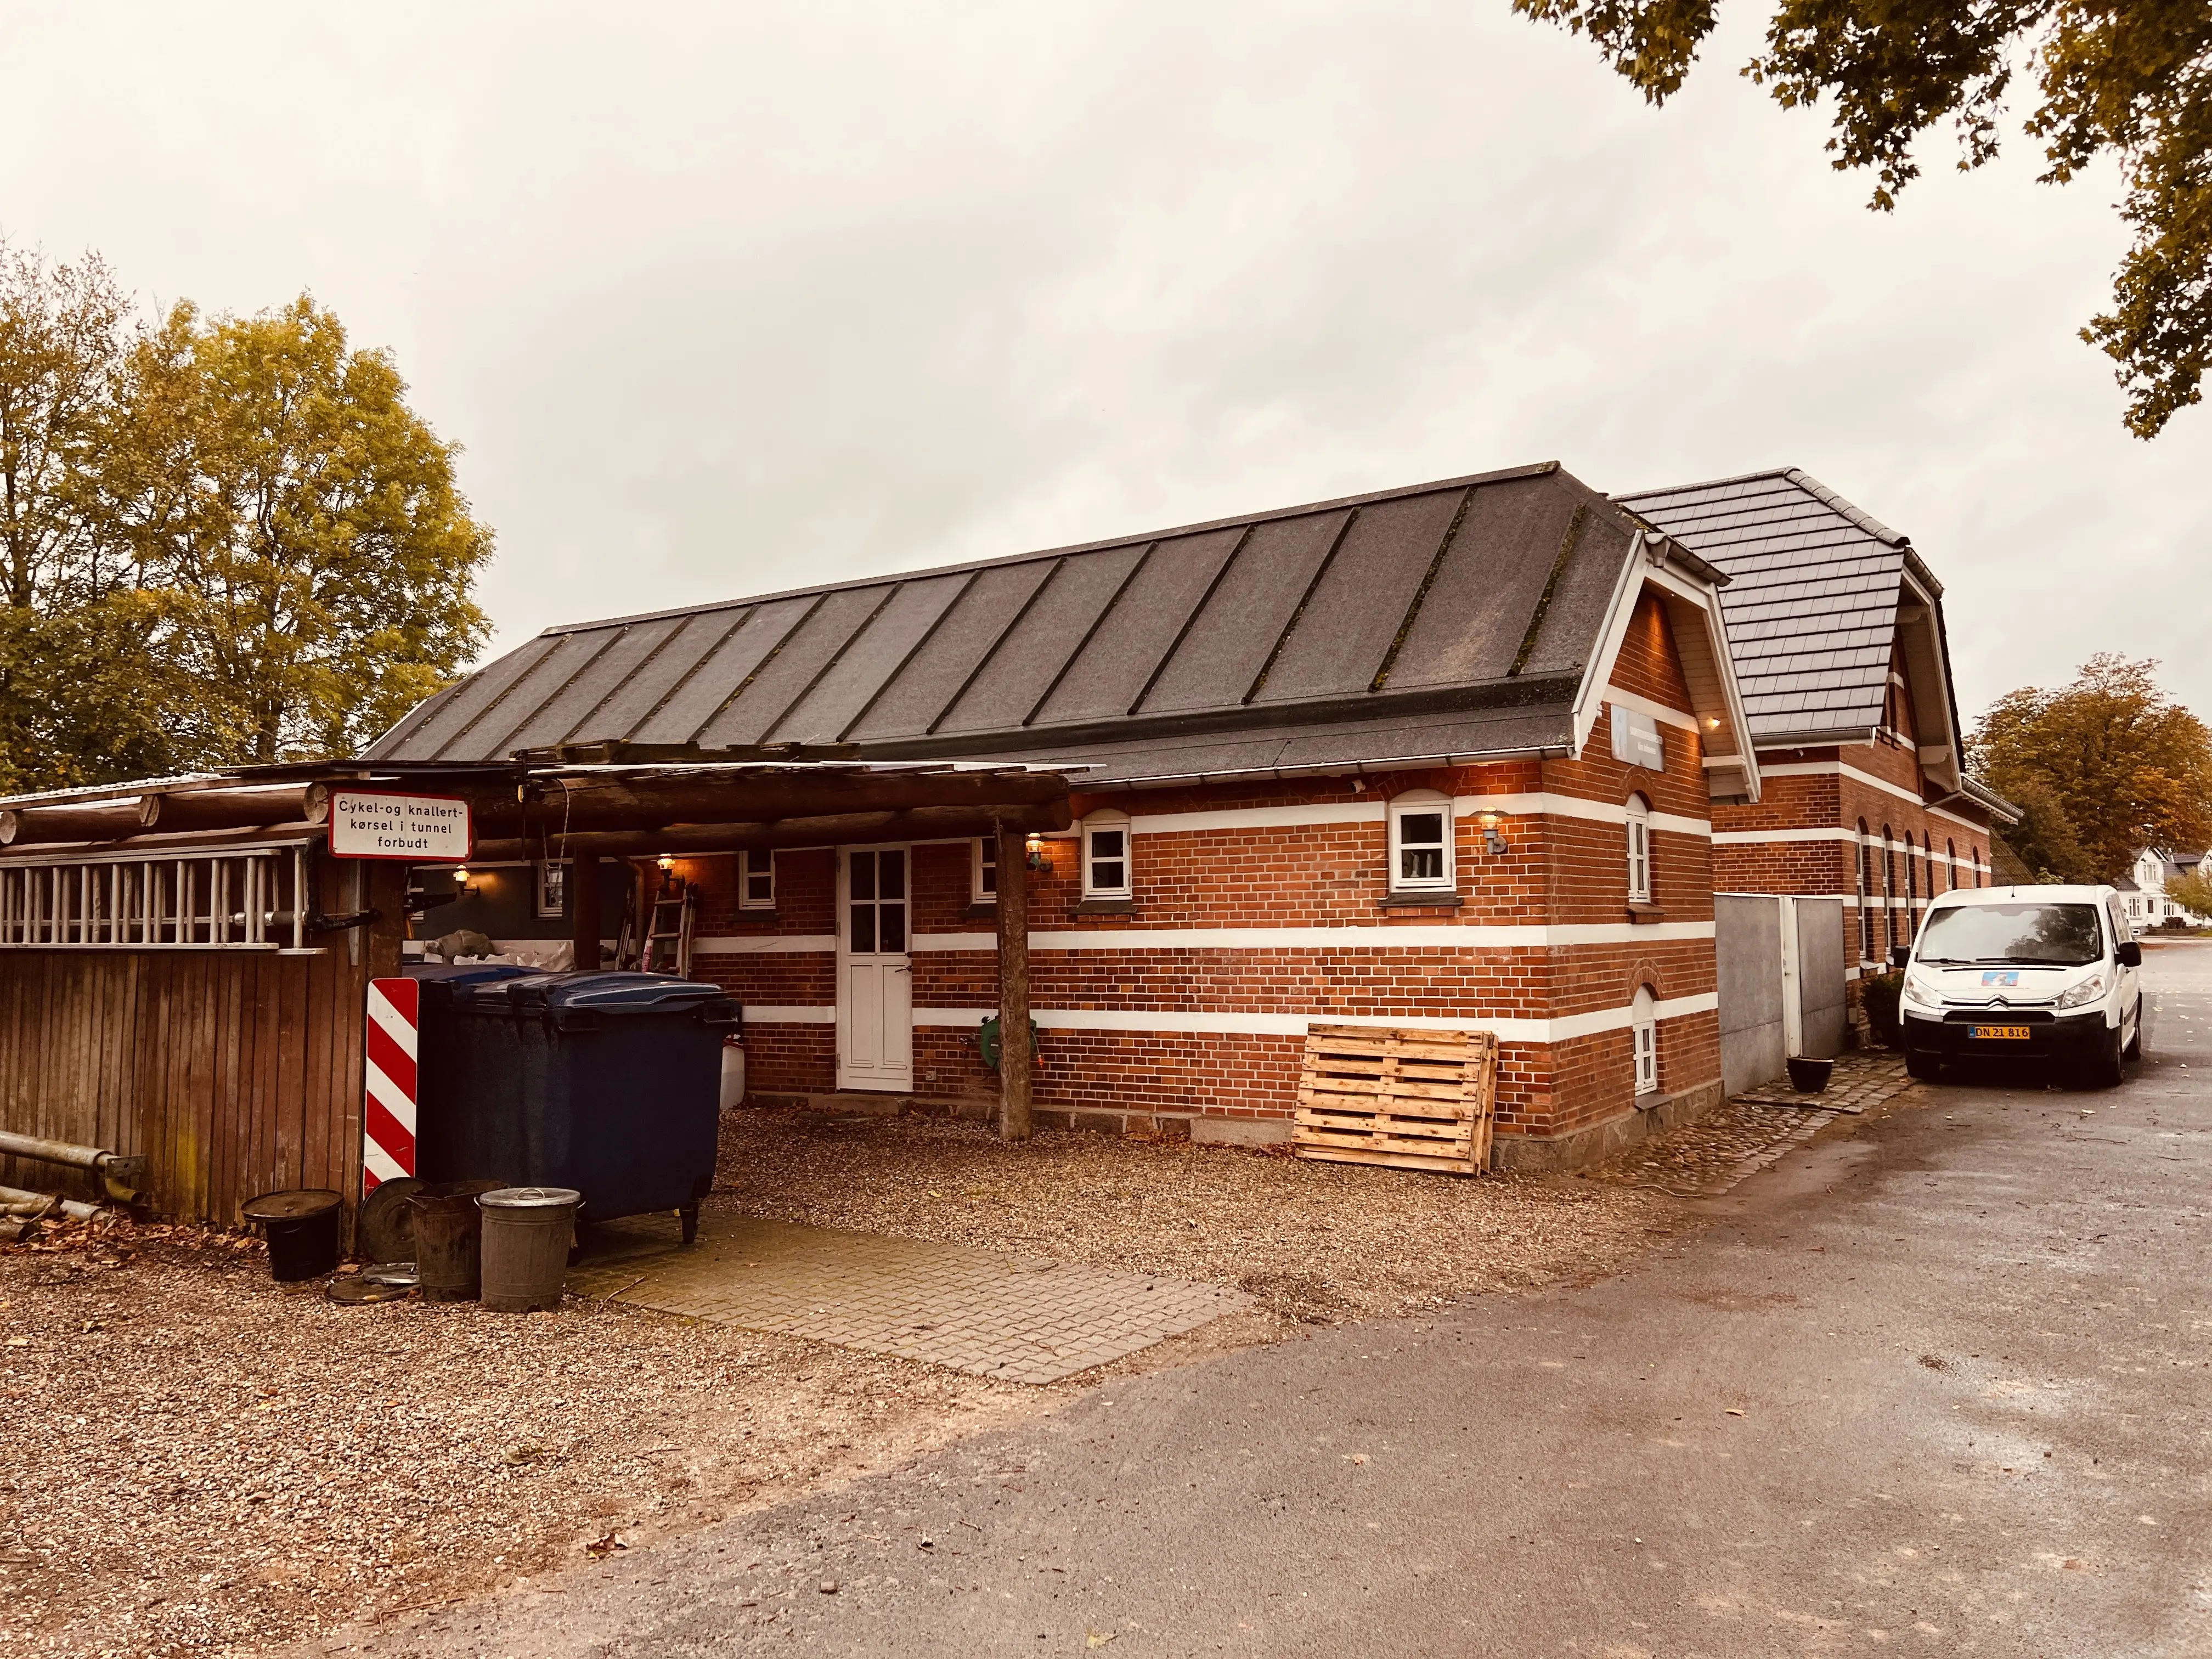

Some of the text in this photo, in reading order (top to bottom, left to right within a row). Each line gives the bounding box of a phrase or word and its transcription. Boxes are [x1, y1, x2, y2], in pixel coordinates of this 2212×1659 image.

[408, 805, 463, 817] knallert-
[351, 819, 452, 833] kørsel i tunnel
[377, 837, 428, 848] forbudt
[1976, 1028, 2028, 1037] DN 21 816
